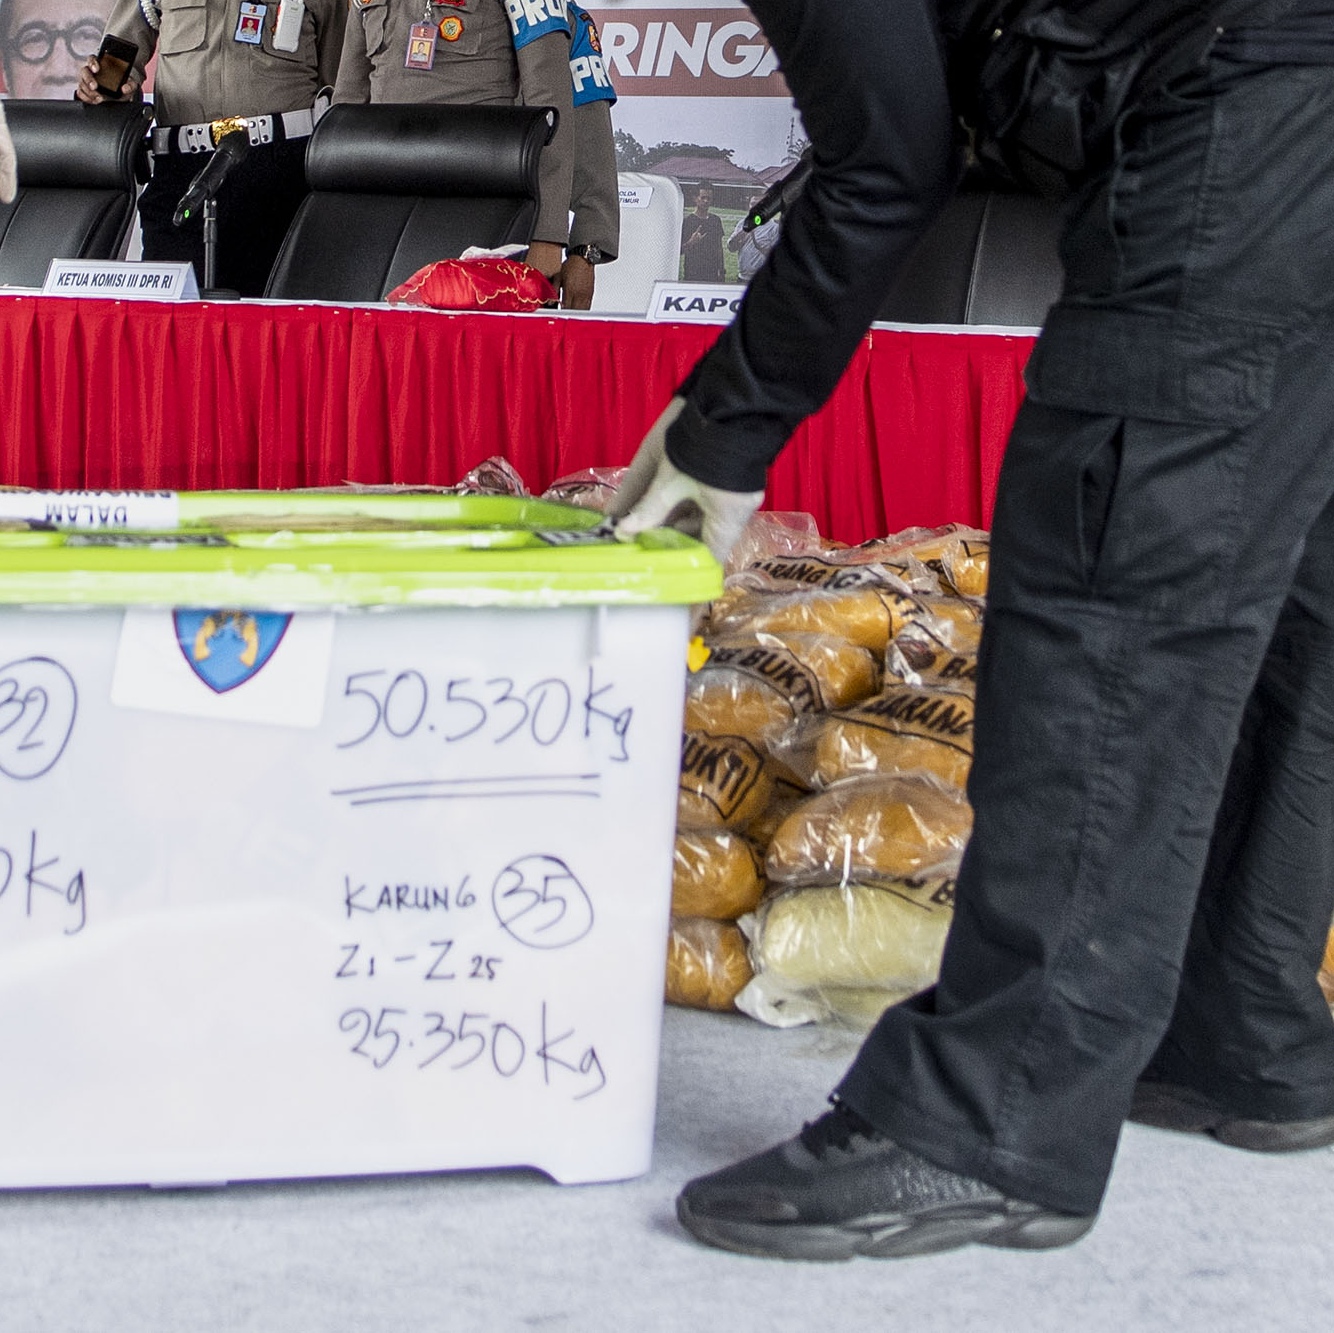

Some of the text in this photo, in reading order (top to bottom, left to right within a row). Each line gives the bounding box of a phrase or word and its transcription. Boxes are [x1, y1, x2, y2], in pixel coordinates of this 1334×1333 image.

[57, 272, 173, 289] KETUA KOMISI III DPR RI
[337, 669, 571, 749] 50.530
[682, 733, 750, 801] UKTI
[501, 867, 571, 933] 35
[339, 1007, 526, 1077] 25.350
